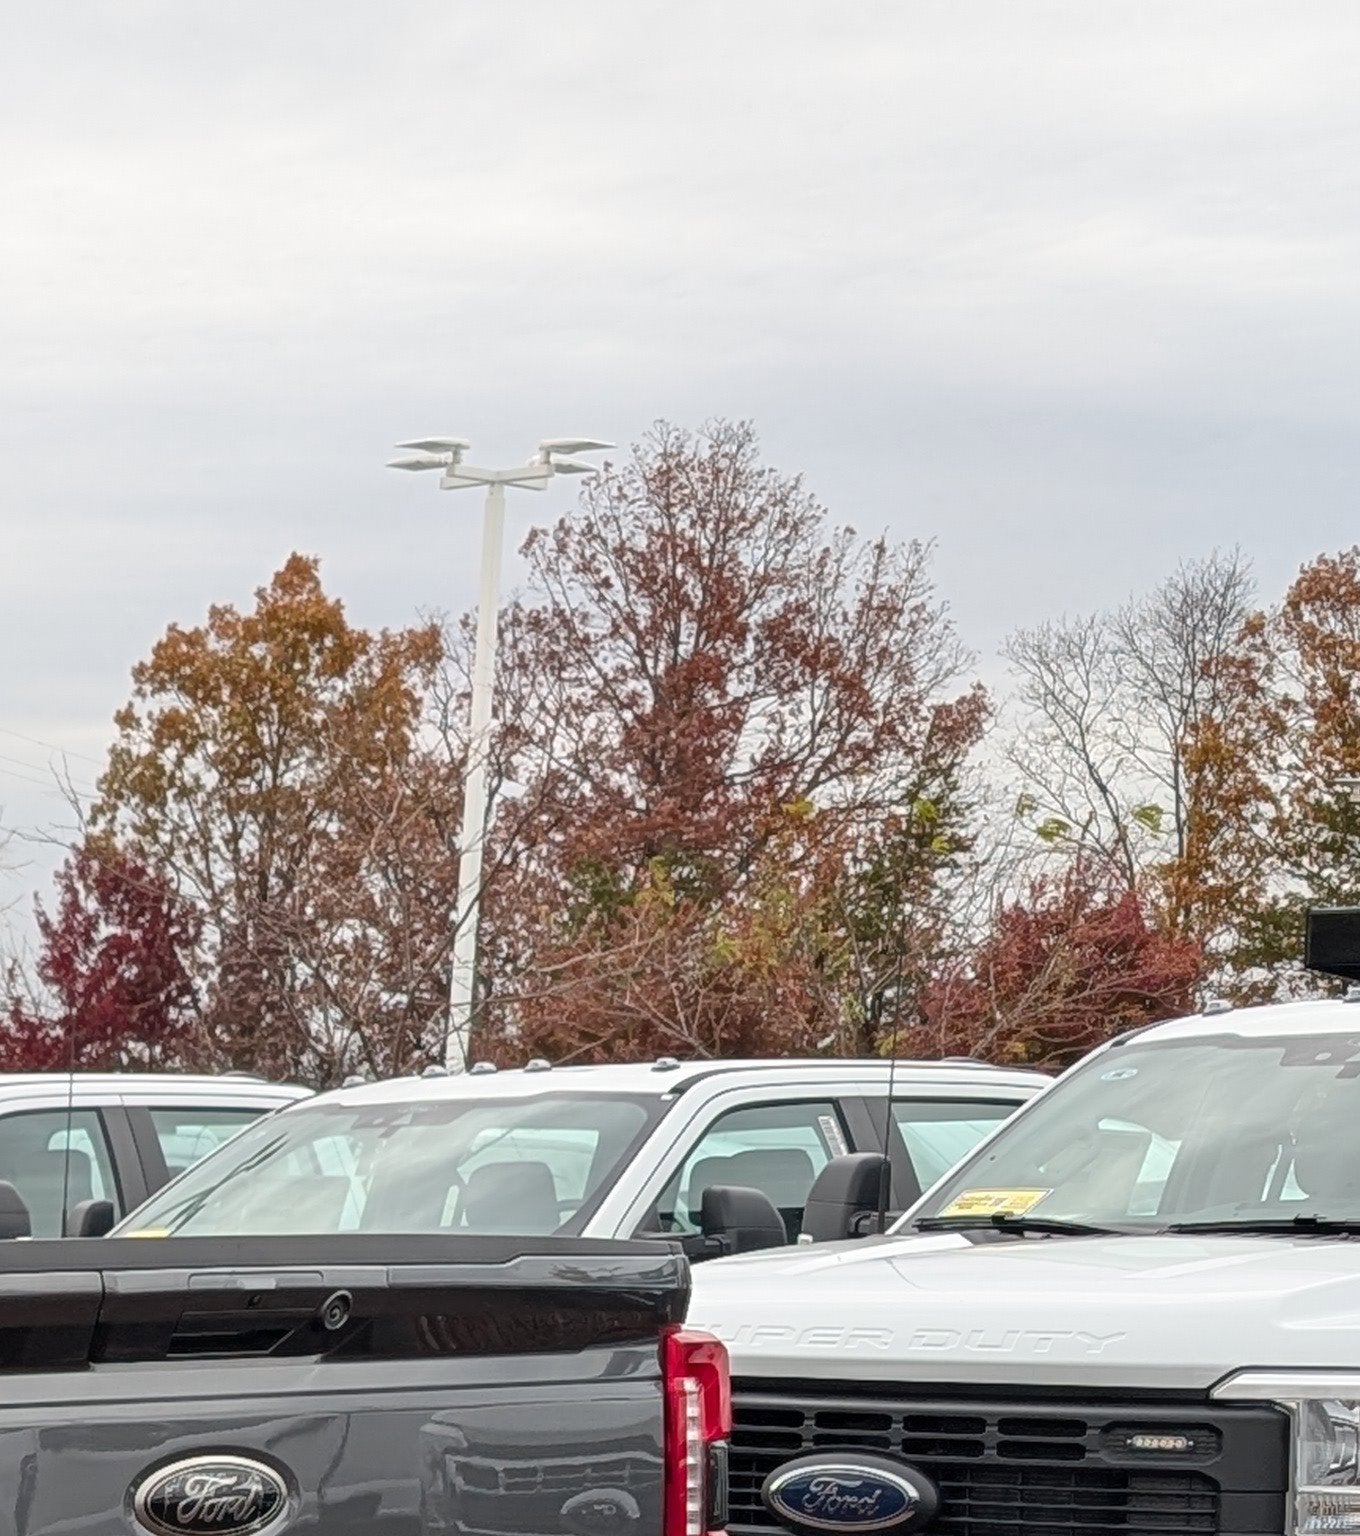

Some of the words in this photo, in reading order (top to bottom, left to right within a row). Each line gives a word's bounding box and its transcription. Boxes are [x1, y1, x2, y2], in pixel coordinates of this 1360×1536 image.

[686, 1323, 896, 1350] UPER
[907, 1327, 1127, 1354] DUTY
[176, 1475, 259, 1525] Ford
[804, 1476, 882, 1516] Ford
